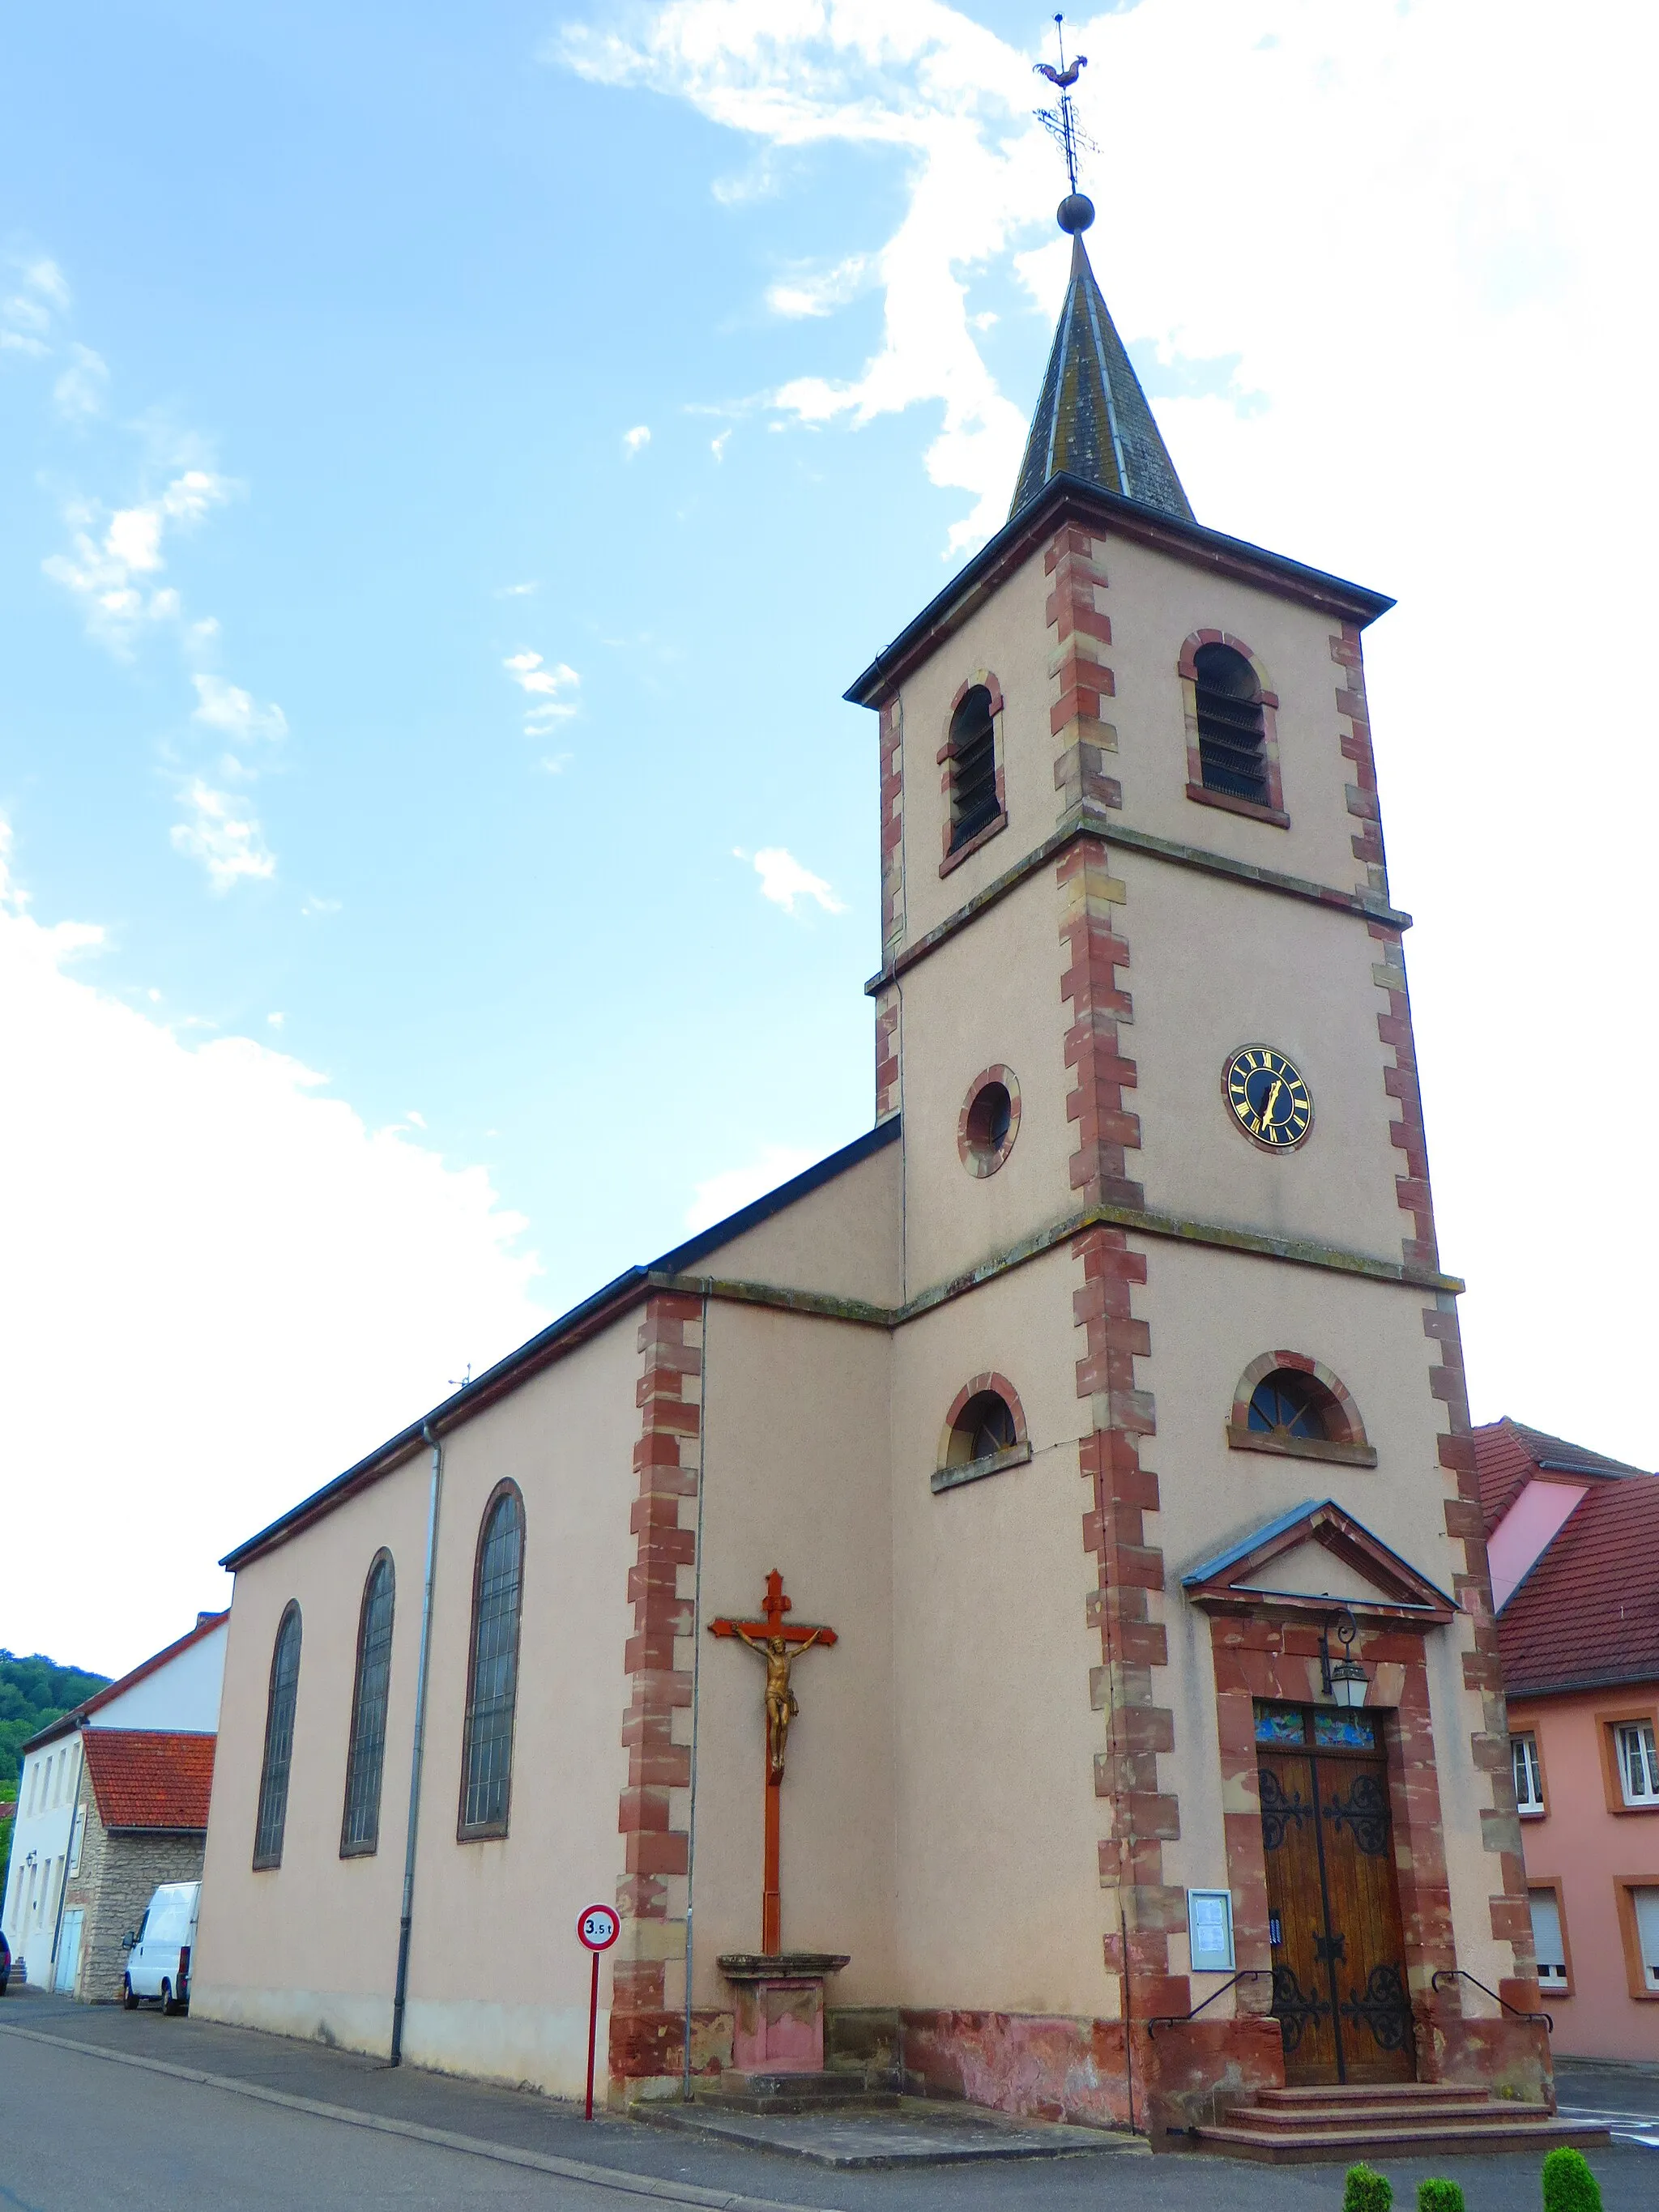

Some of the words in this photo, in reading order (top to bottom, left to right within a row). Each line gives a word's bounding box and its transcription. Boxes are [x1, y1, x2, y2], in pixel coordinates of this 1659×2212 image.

[1245, 1053, 1257, 1069] XI
[1262, 1052, 1273, 1068] XII
[1234, 1064, 1247, 1078] X
[1278, 1062, 1287, 1075] I
[1230, 1083, 1243, 1093] IX
[1289, 1080, 1302, 1089] II
[1294, 1099, 1307, 1110] III
